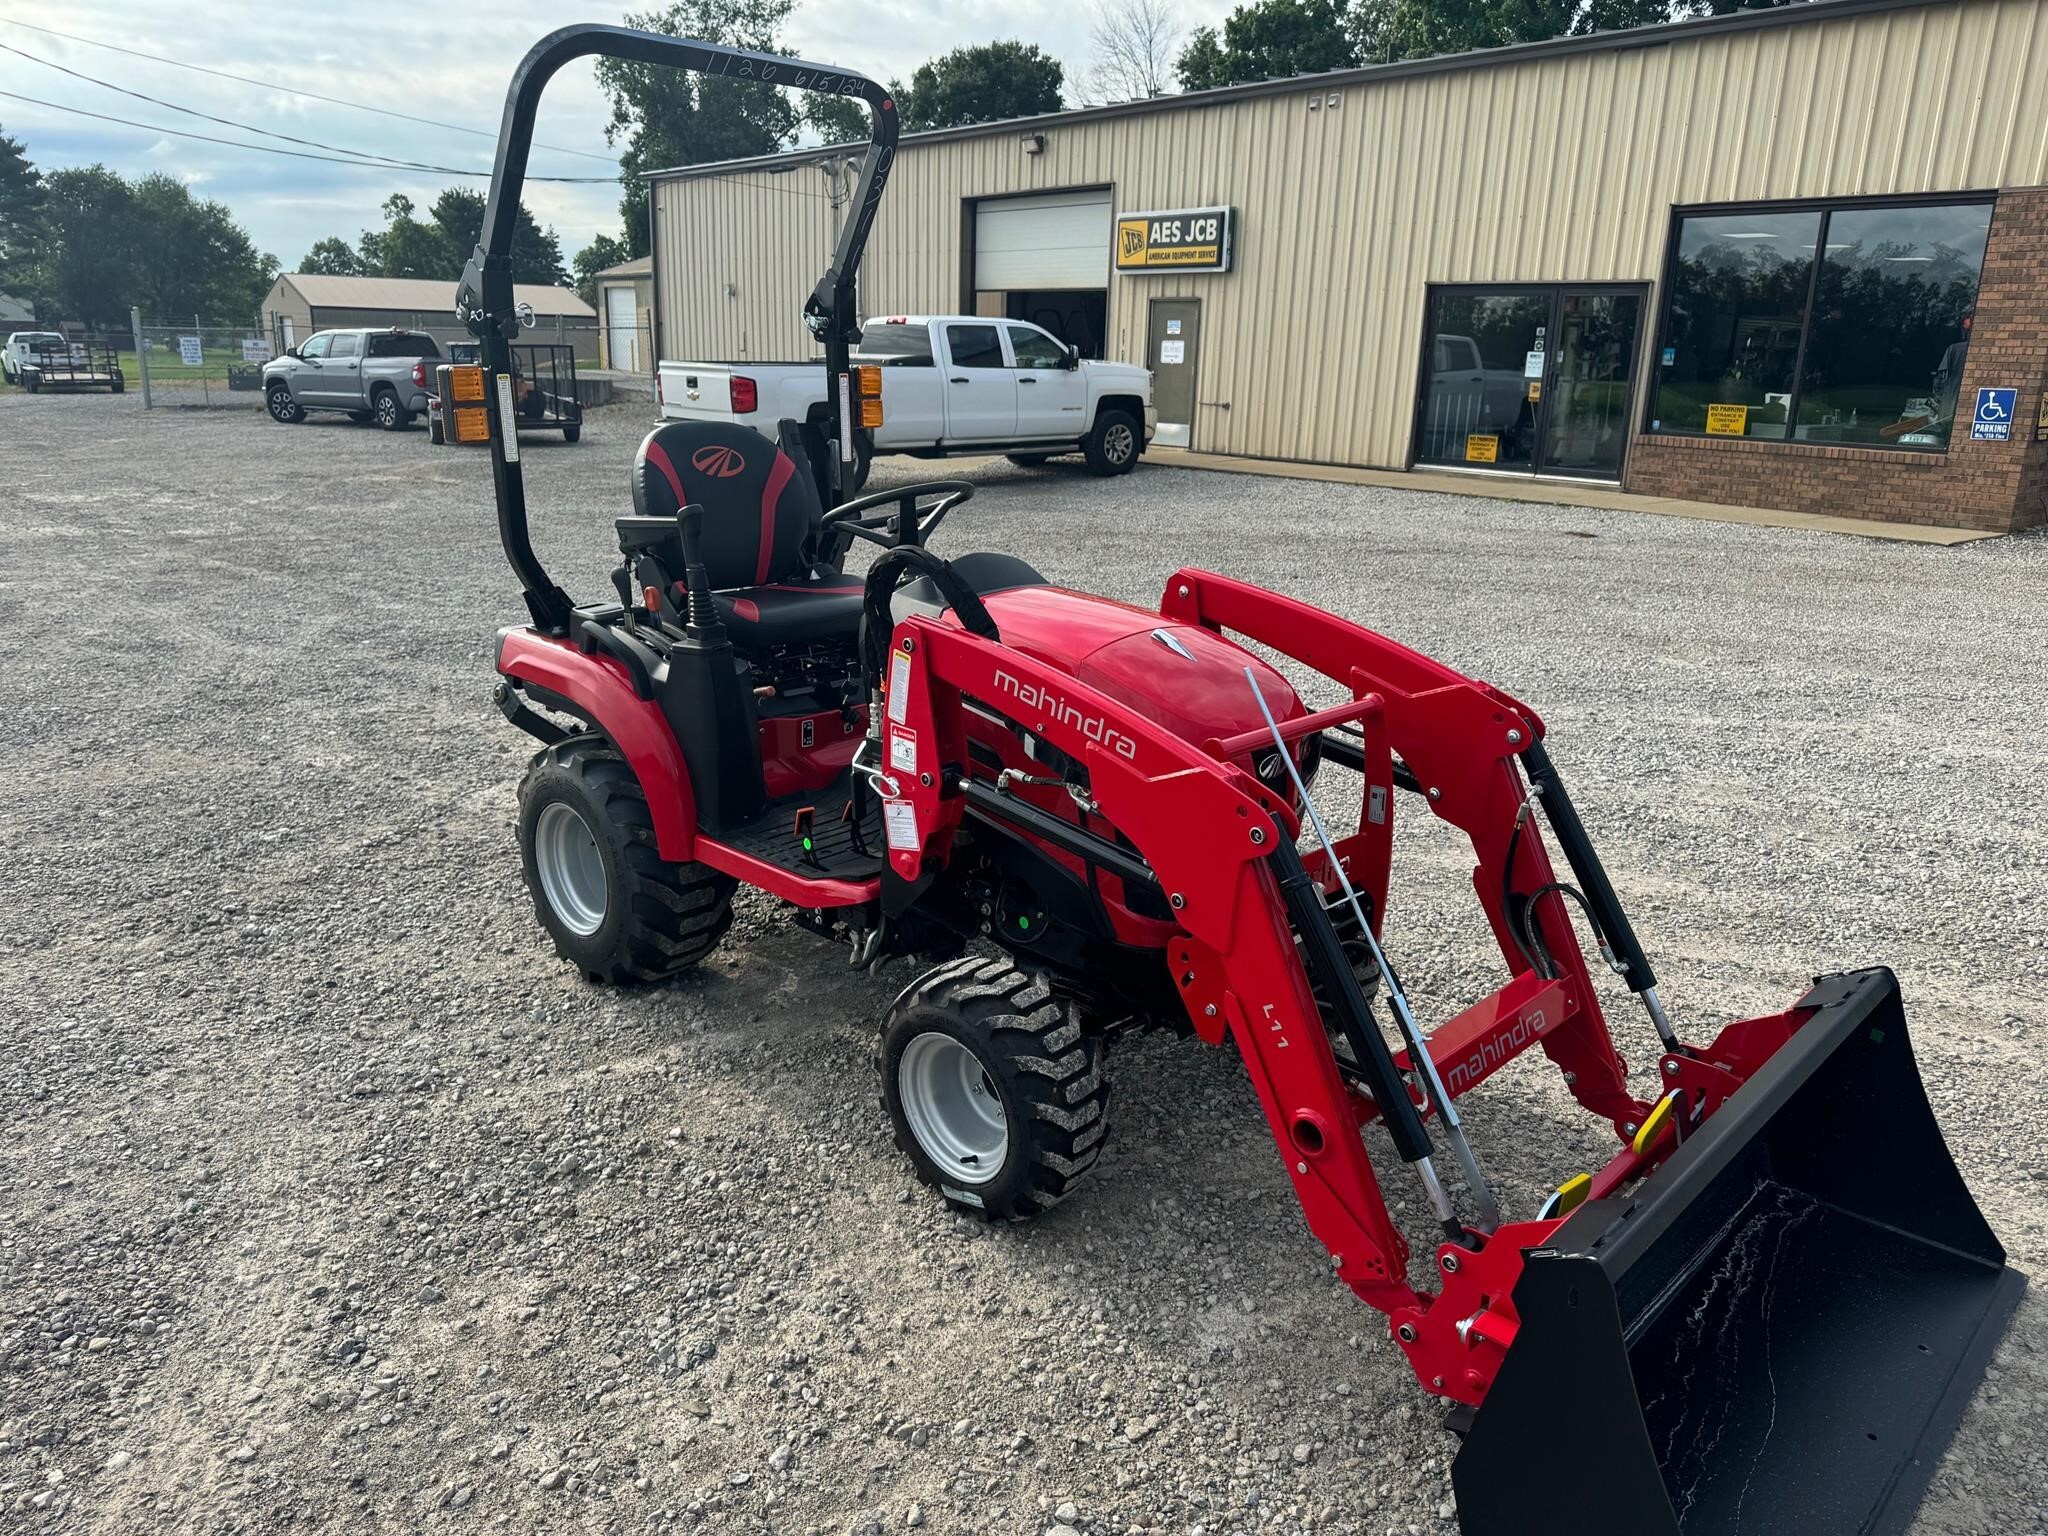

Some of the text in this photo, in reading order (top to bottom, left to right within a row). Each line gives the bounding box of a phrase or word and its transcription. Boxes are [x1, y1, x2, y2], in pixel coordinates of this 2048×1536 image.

[795, 70, 866, 96] 6/5/24
[1125, 231, 1143, 255] JCB
[1150, 219, 1217, 243] AES JCB
[1149, 250, 1216, 261] AMERICAN EQUIPMENT SERVICE
[1975, 424, 2007, 433] PARKING
[993, 669, 1136, 760] mahindra
[1263, 1003, 1289, 1048] L11
[1447, 1009, 1546, 1092] mahindra
